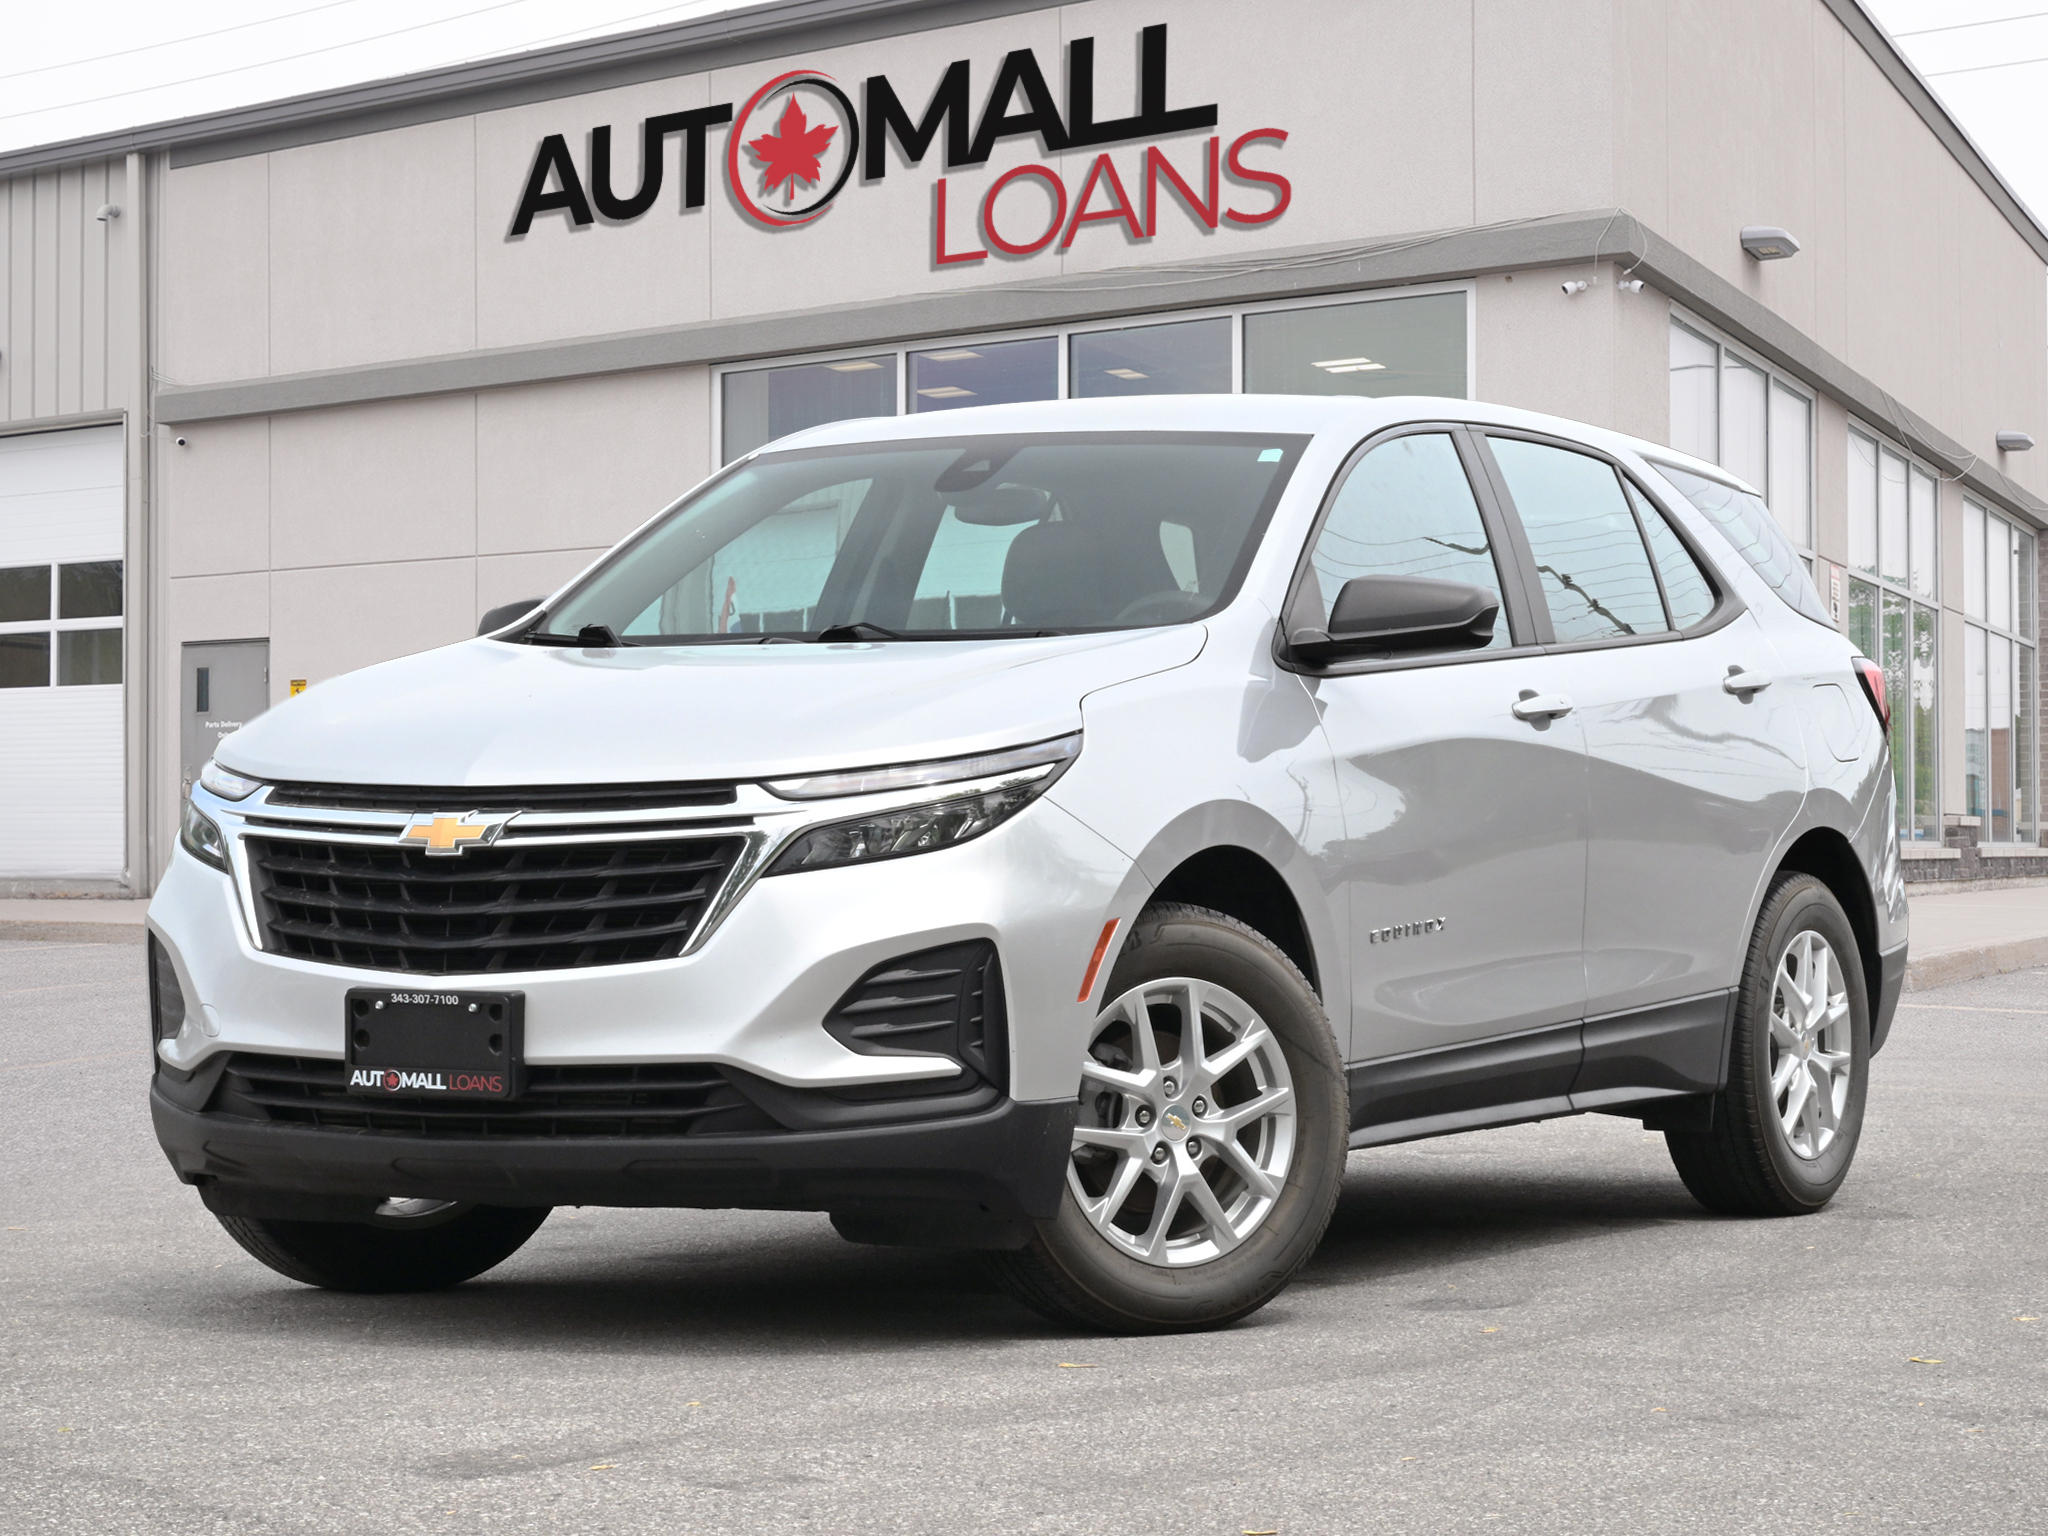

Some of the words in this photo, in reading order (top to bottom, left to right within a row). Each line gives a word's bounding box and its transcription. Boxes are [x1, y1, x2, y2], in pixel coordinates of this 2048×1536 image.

[509, 23, 1218, 236] AUTOMALL
[935, 128, 1292, 265] LOANS
[220, 721, 242, 730] Delivery
[1369, 917, 1446, 944] EQUINOX
[391, 993, 459, 1005] 343-307-7100
[350, 1068, 447, 1092] AUTOMALL
[449, 1073, 502, 1092] LOANS
